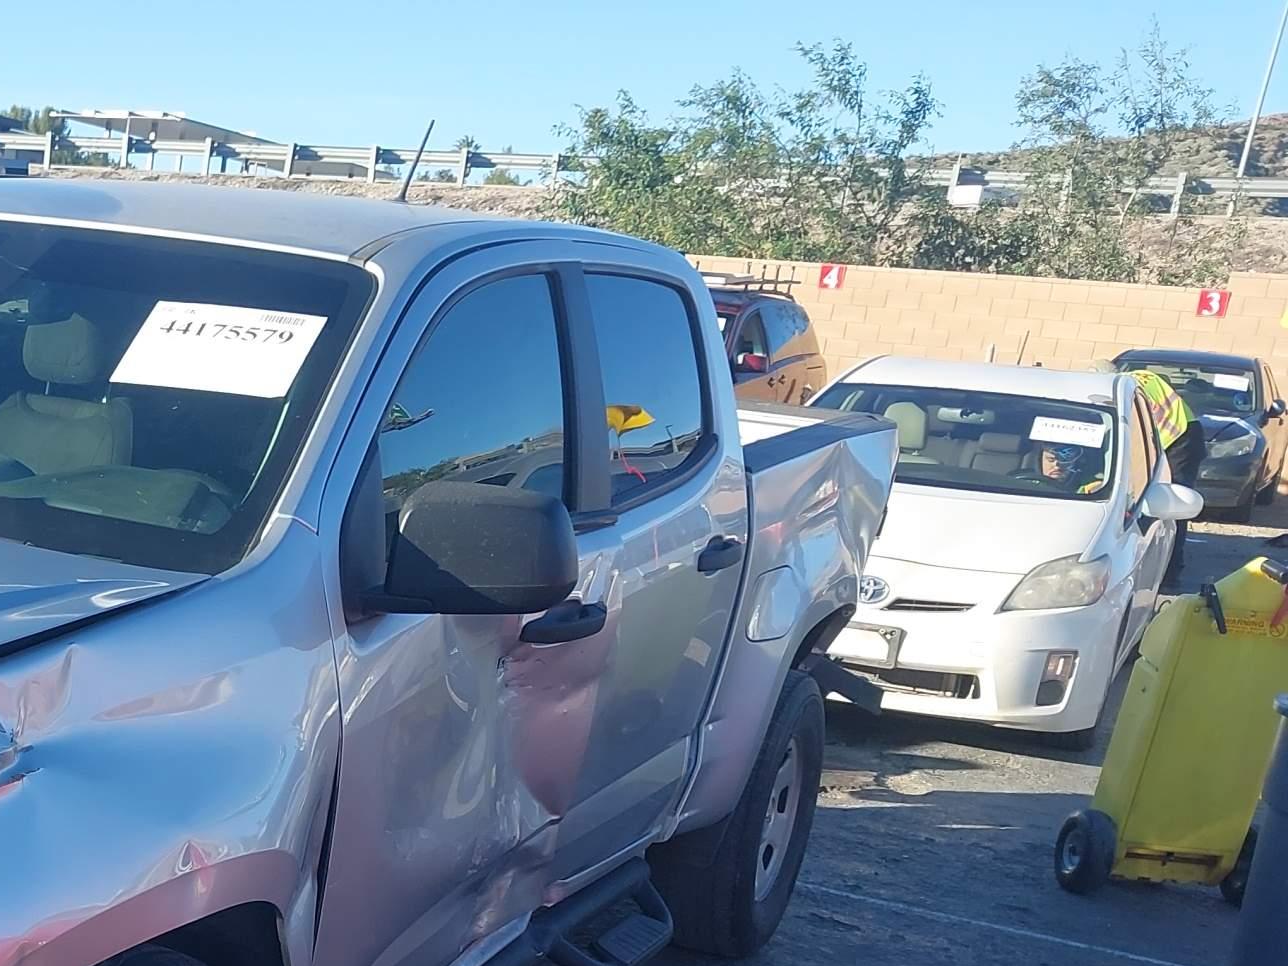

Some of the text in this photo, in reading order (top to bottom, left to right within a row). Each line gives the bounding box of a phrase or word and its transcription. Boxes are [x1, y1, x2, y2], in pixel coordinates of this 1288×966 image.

[822, 265, 841, 288] 4
[1201, 292, 1221, 316] 3
[159, 319, 294, 345] 44175579
